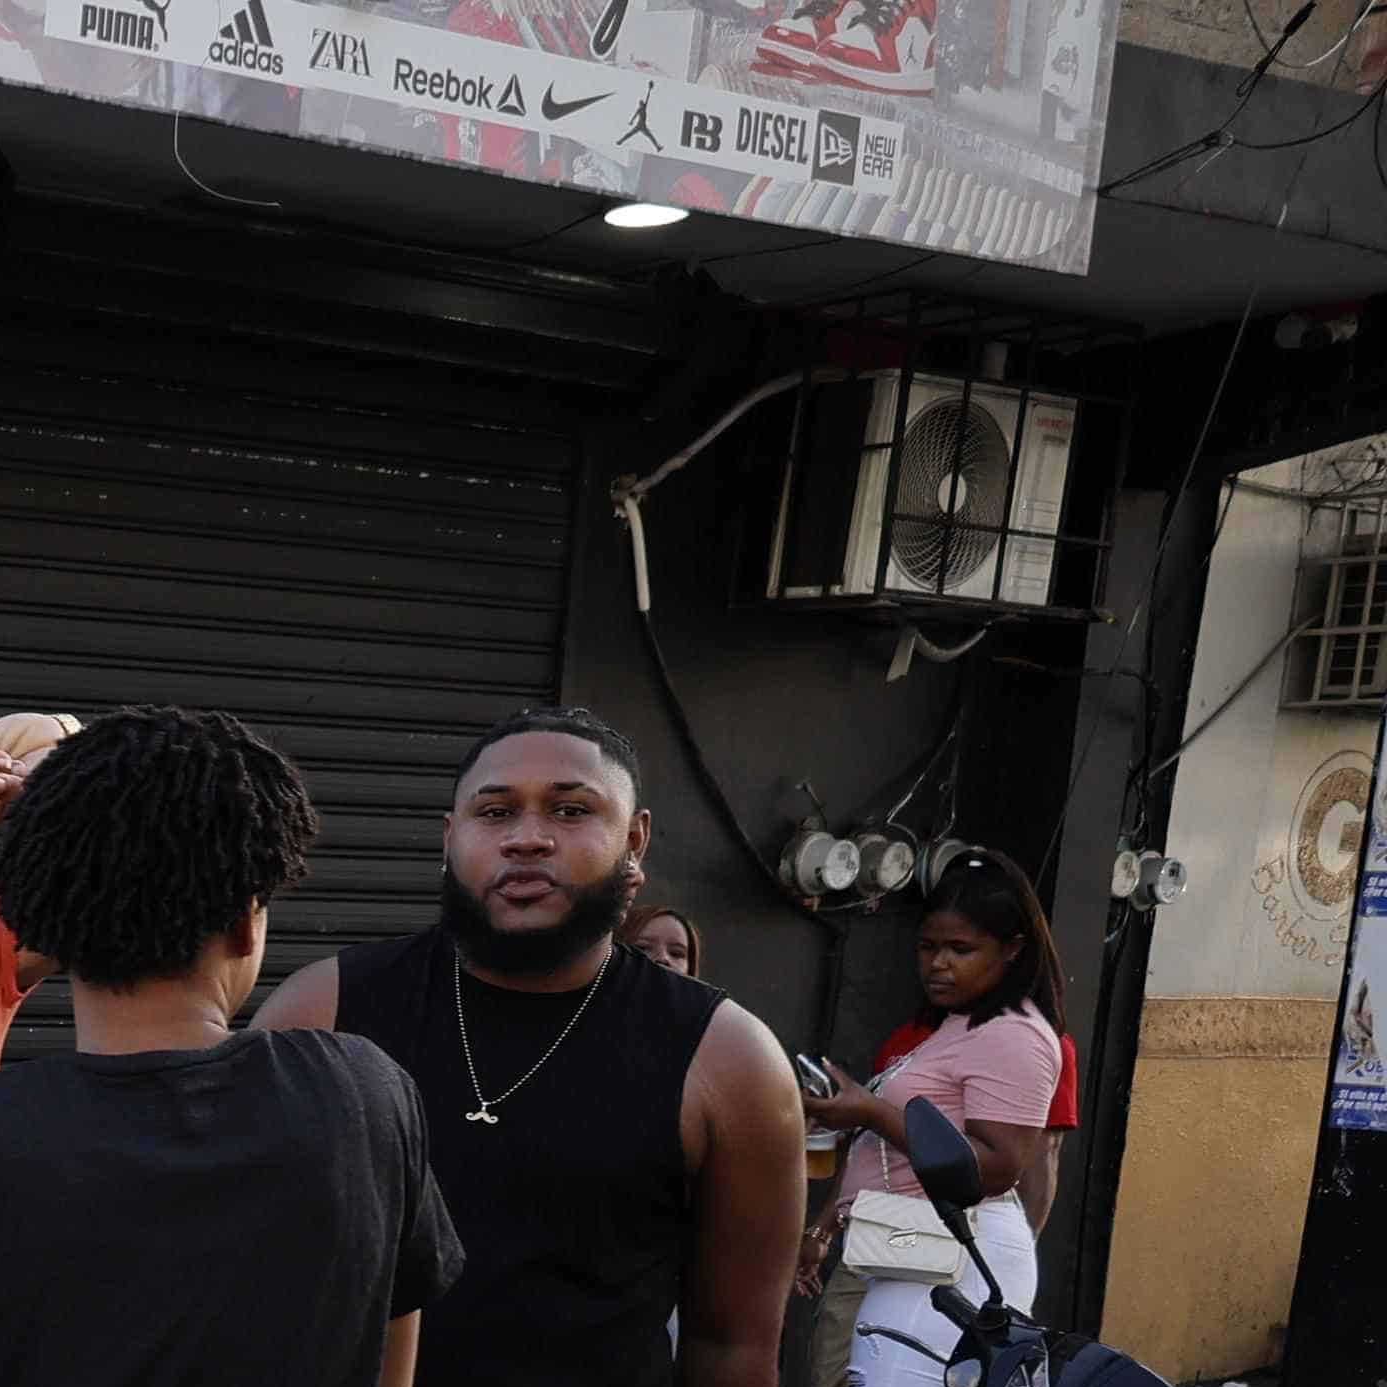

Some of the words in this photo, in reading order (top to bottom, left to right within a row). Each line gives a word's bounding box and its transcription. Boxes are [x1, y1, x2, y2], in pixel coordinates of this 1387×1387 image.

[80, 4, 154, 51] PUMA
[208, 40, 284, 76] adidas
[309, 27, 373, 78] ZARA
[393, 58, 494, 110] Reebok
[736, 107, 808, 165] DIESEL
[863, 133, 896, 159] NEW
[861, 157, 893, 180] ERA
